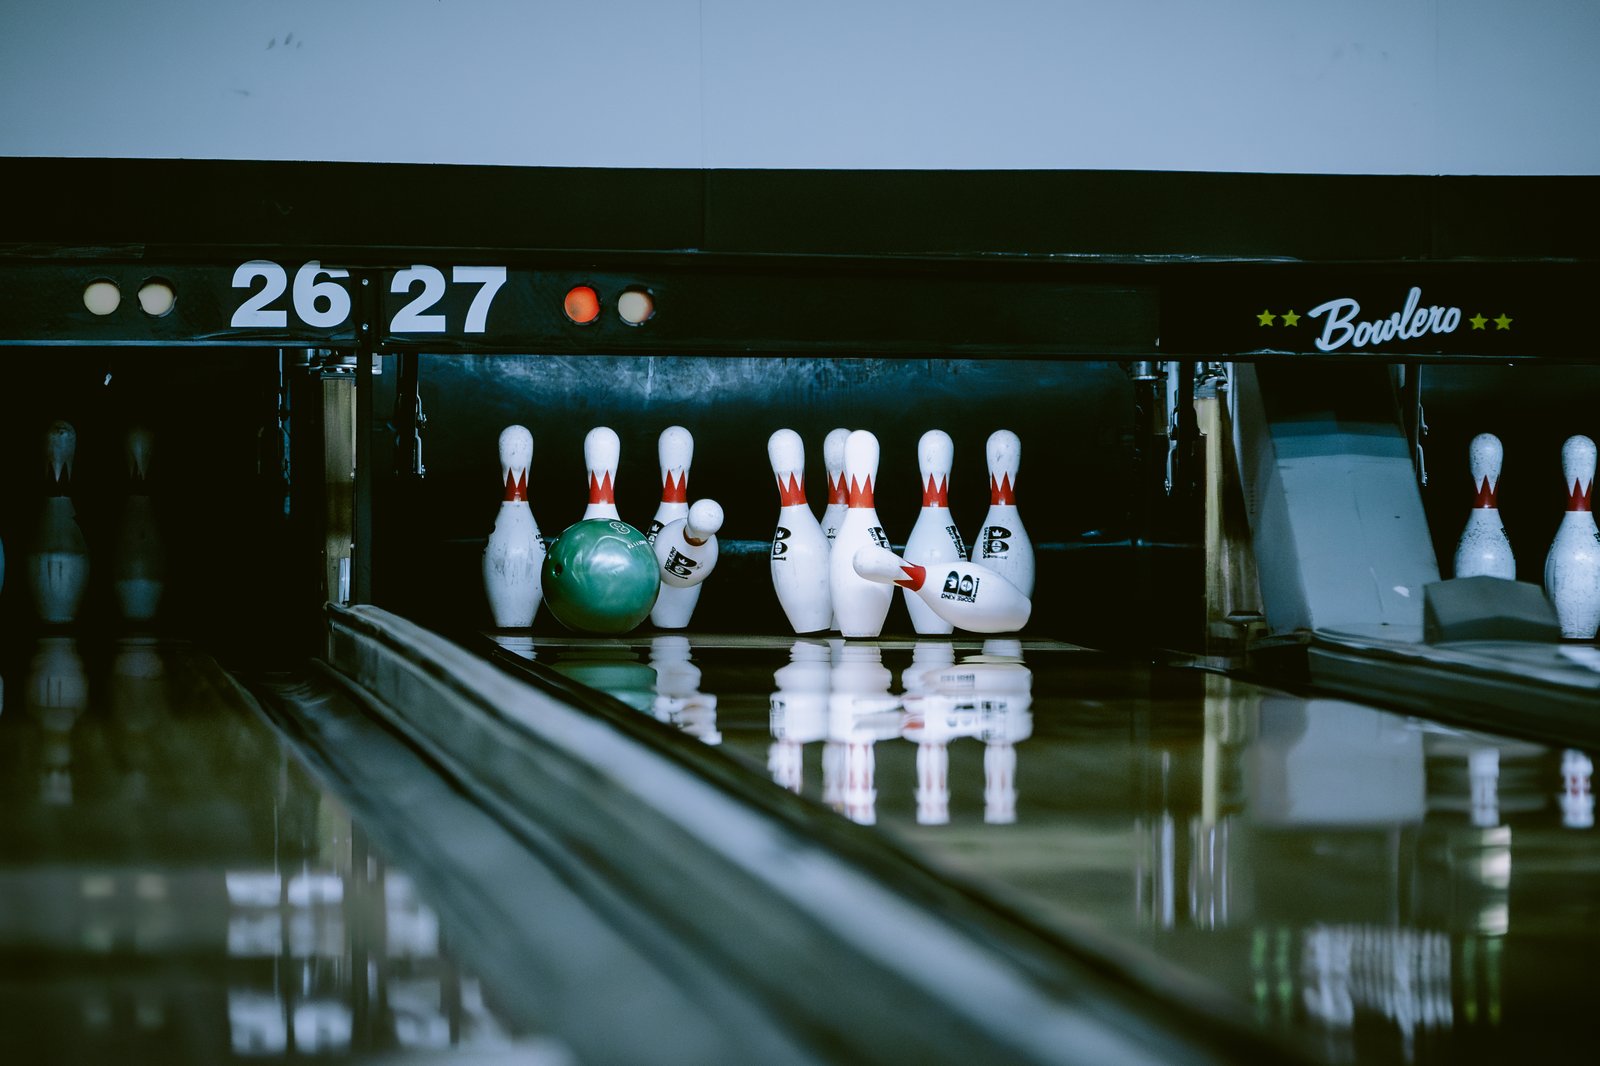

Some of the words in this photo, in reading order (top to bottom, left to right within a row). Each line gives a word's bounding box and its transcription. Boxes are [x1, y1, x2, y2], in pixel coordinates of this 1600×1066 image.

[231, 259, 351, 328] 26
[389, 264, 507, 333] 27
[1307, 286, 1462, 352] Bowlero
